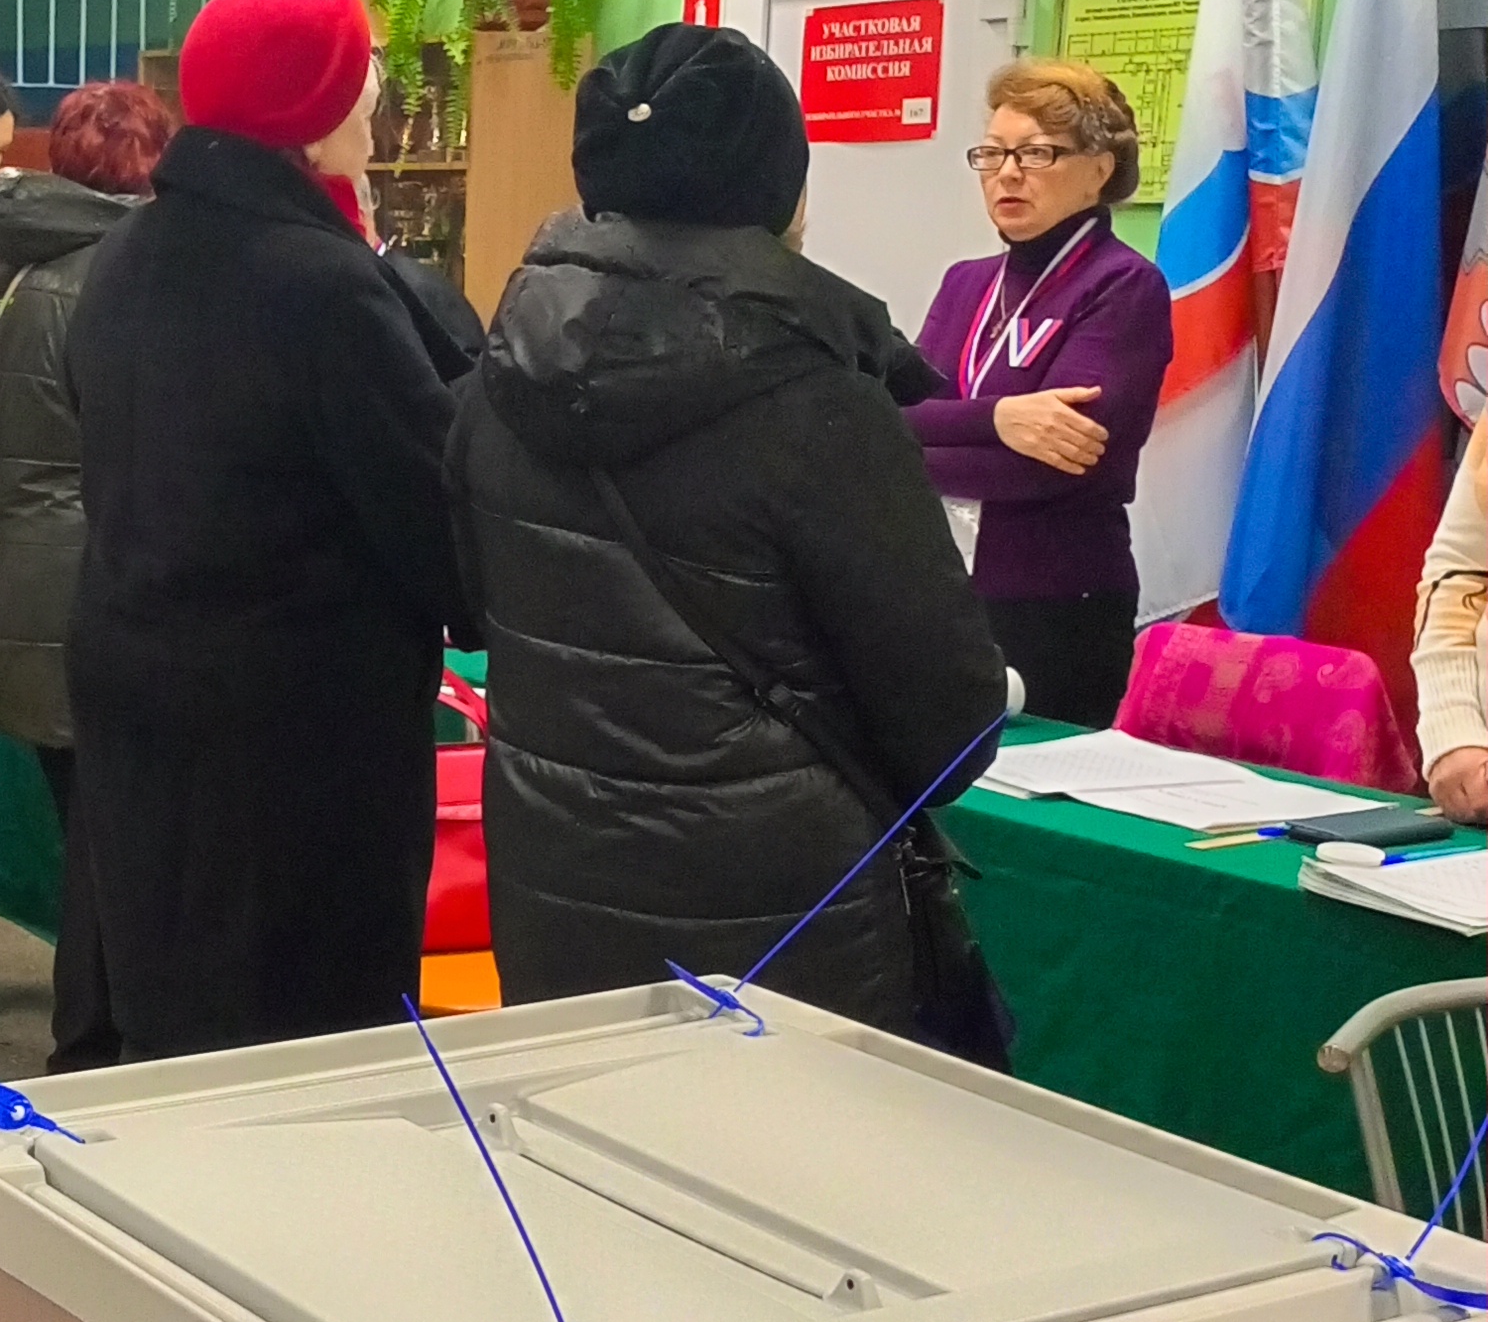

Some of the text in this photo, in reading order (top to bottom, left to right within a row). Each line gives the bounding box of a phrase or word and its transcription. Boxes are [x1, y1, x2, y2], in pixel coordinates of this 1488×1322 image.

[822, 14, 922, 40] УЧАСТКОВАЯ
[810, 36, 934, 62] ИЗБИРАТЕЛЬНАЯ
[826, 60, 912, 83] КОМИССИЯ
